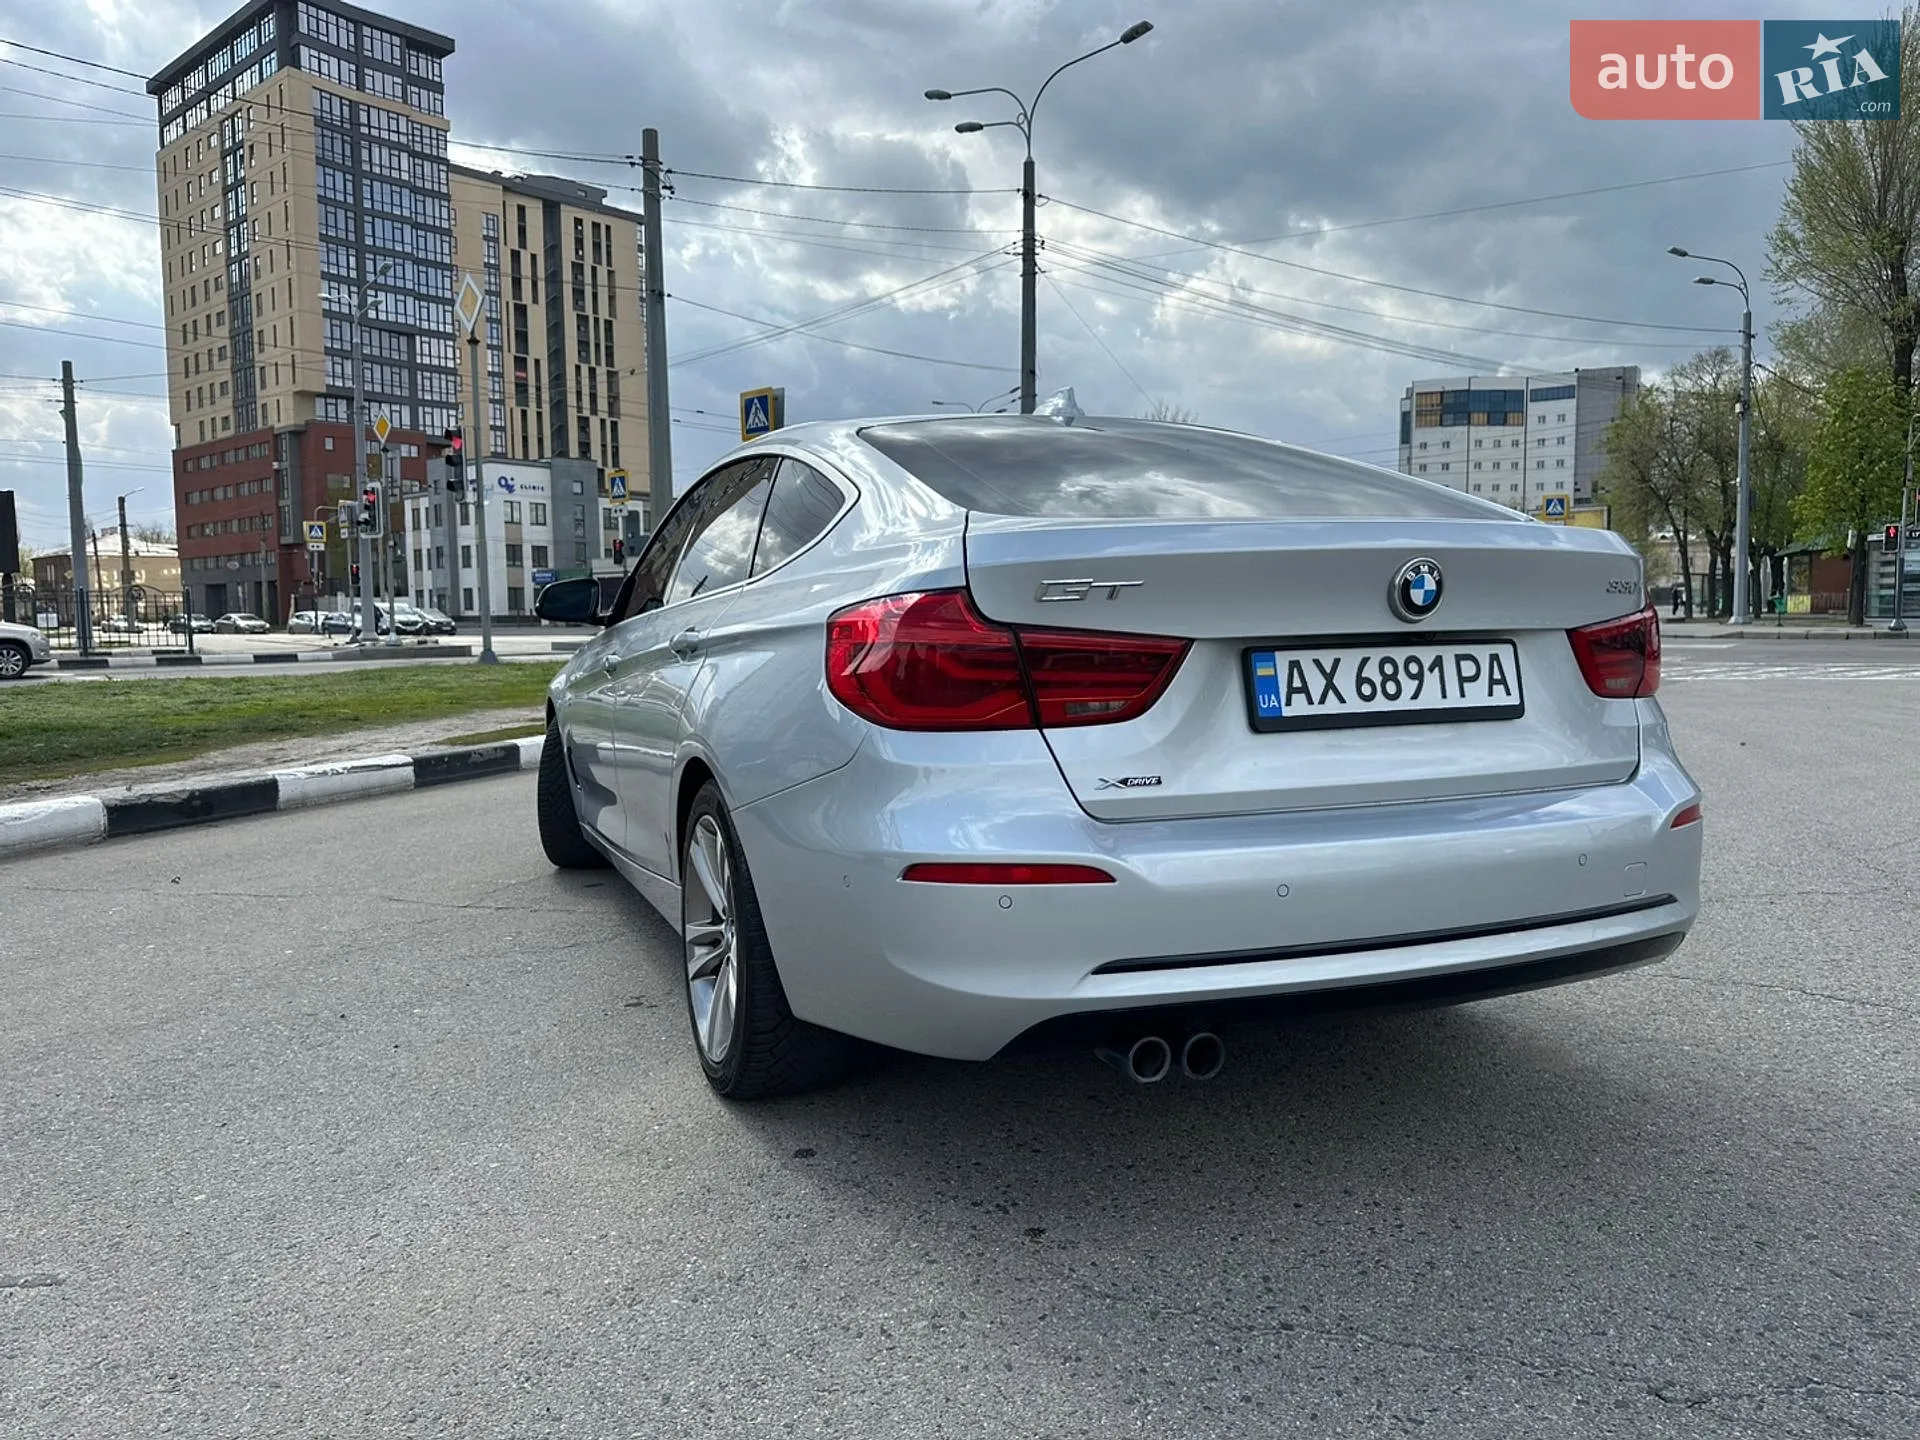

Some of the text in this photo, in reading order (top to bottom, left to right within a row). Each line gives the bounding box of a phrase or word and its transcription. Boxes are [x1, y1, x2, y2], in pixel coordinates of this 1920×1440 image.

[1404, 565, 1440, 581] BMW
[1034, 578, 1144, 602] GT
[1285, 653, 1512, 707] AX 6891 PA
[1259, 694, 1279, 709] UA
